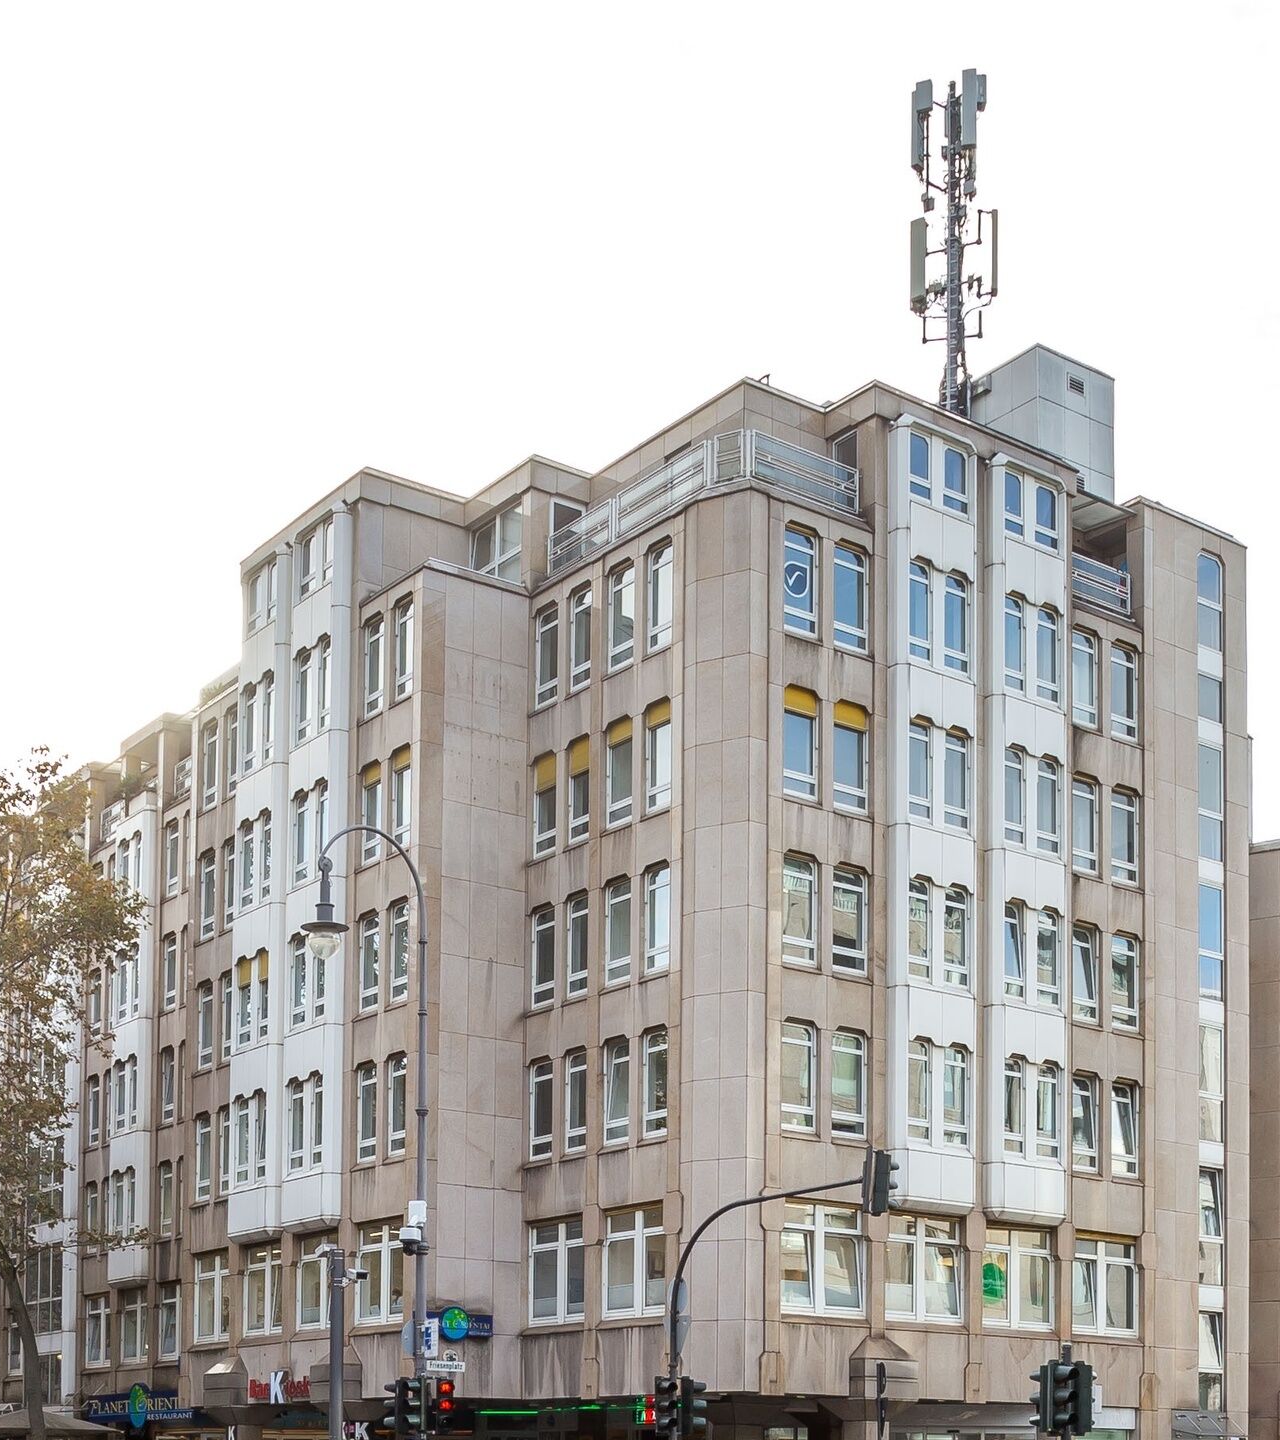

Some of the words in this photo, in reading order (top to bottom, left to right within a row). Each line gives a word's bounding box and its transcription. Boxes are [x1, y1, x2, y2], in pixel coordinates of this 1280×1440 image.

[429, 1361, 464, 1371] Friesenplatz
[90, 1399, 130, 1415] PLANET
[146, 1412, 193, 1420] RESTAURANT
